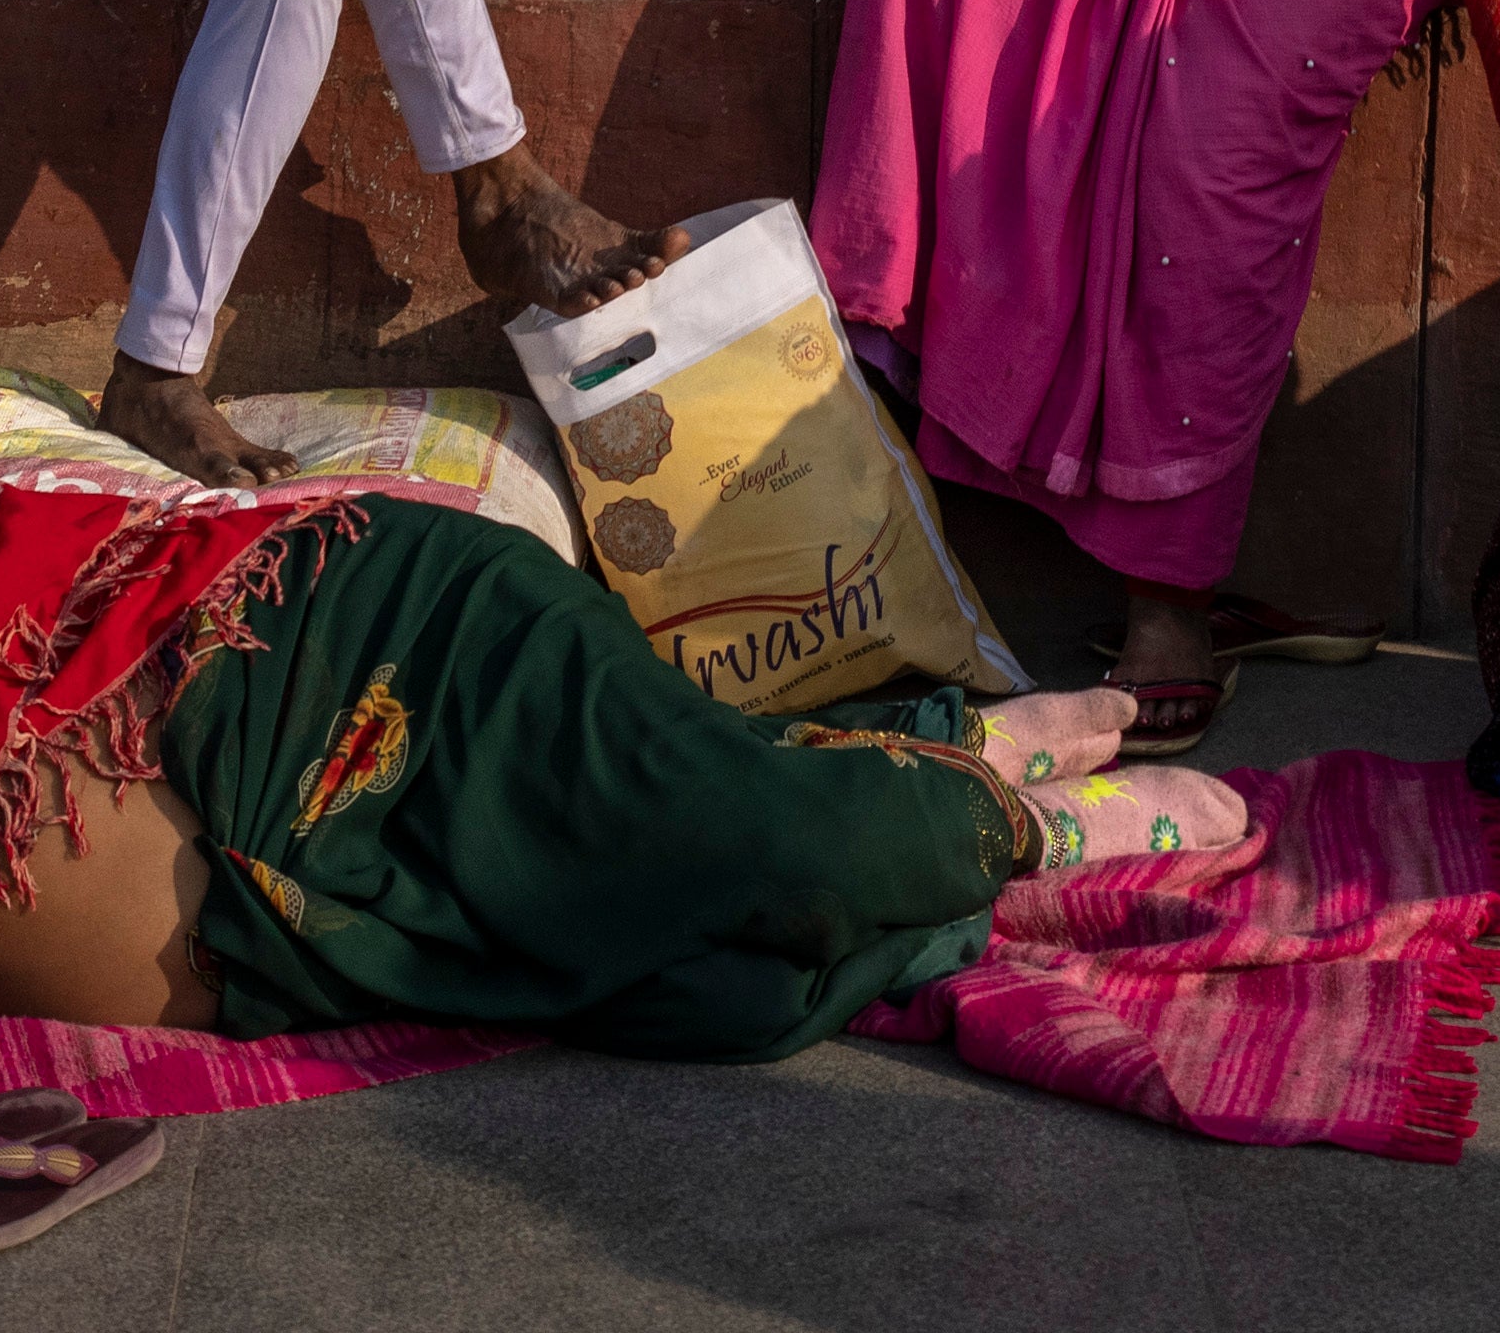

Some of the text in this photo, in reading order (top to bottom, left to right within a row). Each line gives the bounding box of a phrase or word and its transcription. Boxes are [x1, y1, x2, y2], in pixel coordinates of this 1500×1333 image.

[792, 340, 822, 365] 1968
[719, 449, 790, 503] Elegant
[769, 461, 813, 493] Ethnic
[770, 661, 833, 699] LEHENGAS
[844, 633, 896, 664] DRESSES
